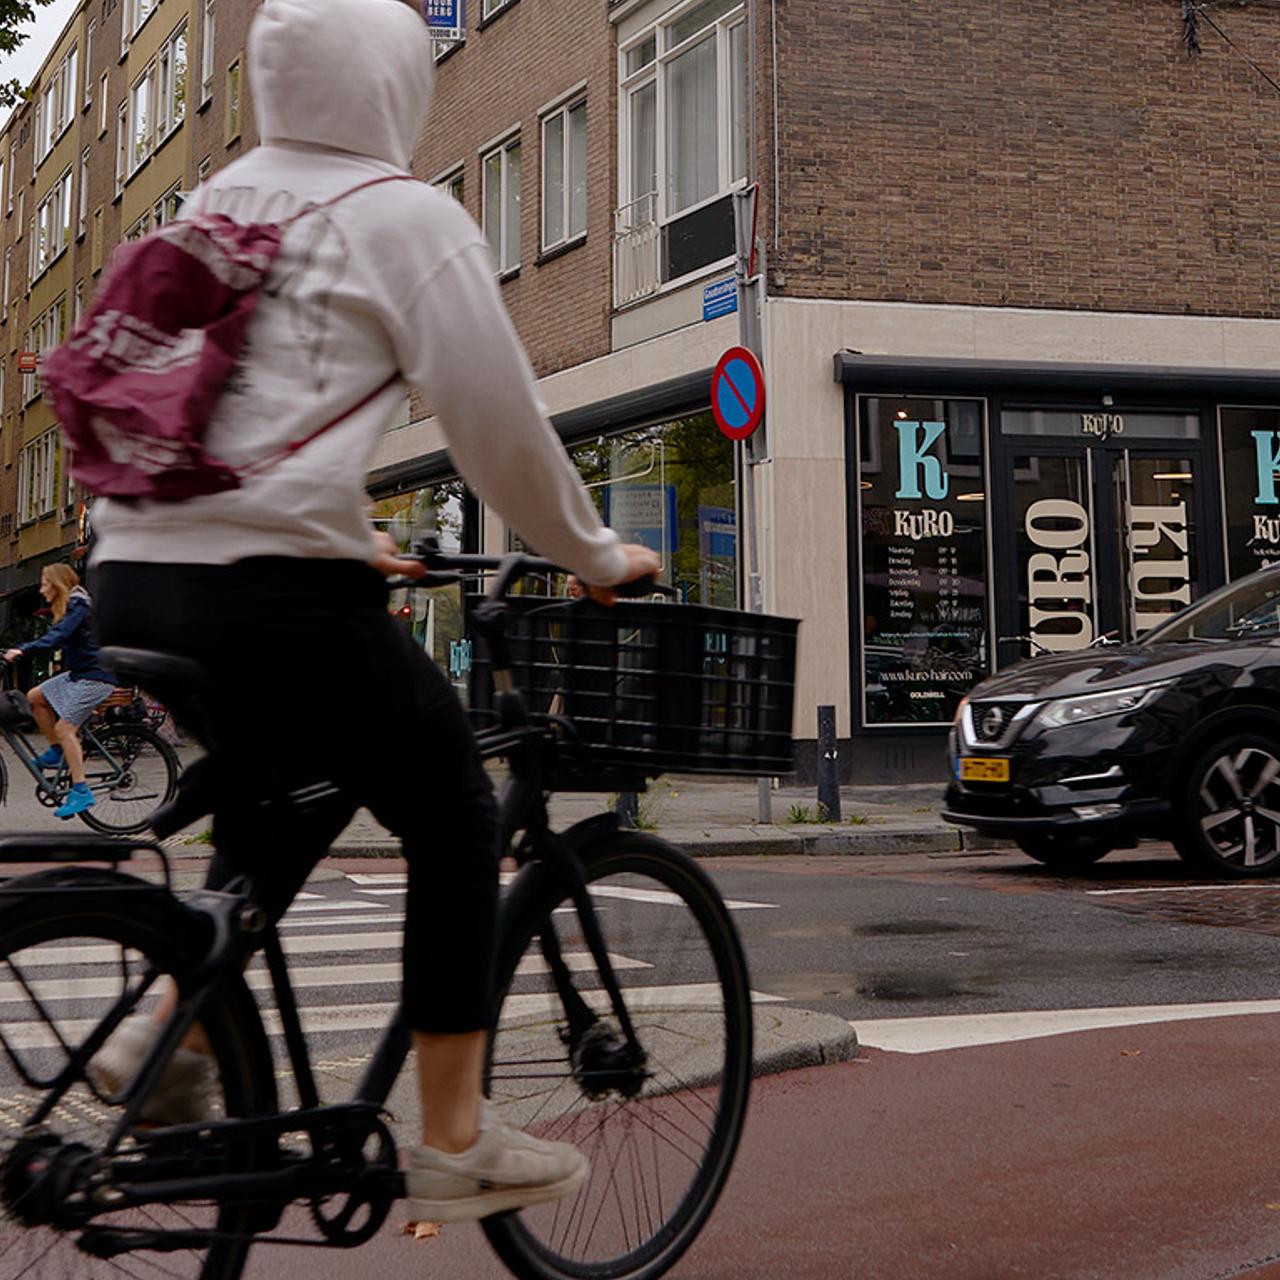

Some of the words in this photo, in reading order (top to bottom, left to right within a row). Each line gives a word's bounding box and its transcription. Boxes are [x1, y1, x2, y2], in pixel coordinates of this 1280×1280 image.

[893, 420, 949, 500] K
[893, 509, 954, 541] KURO
[1025, 498, 1094, 657] URO
